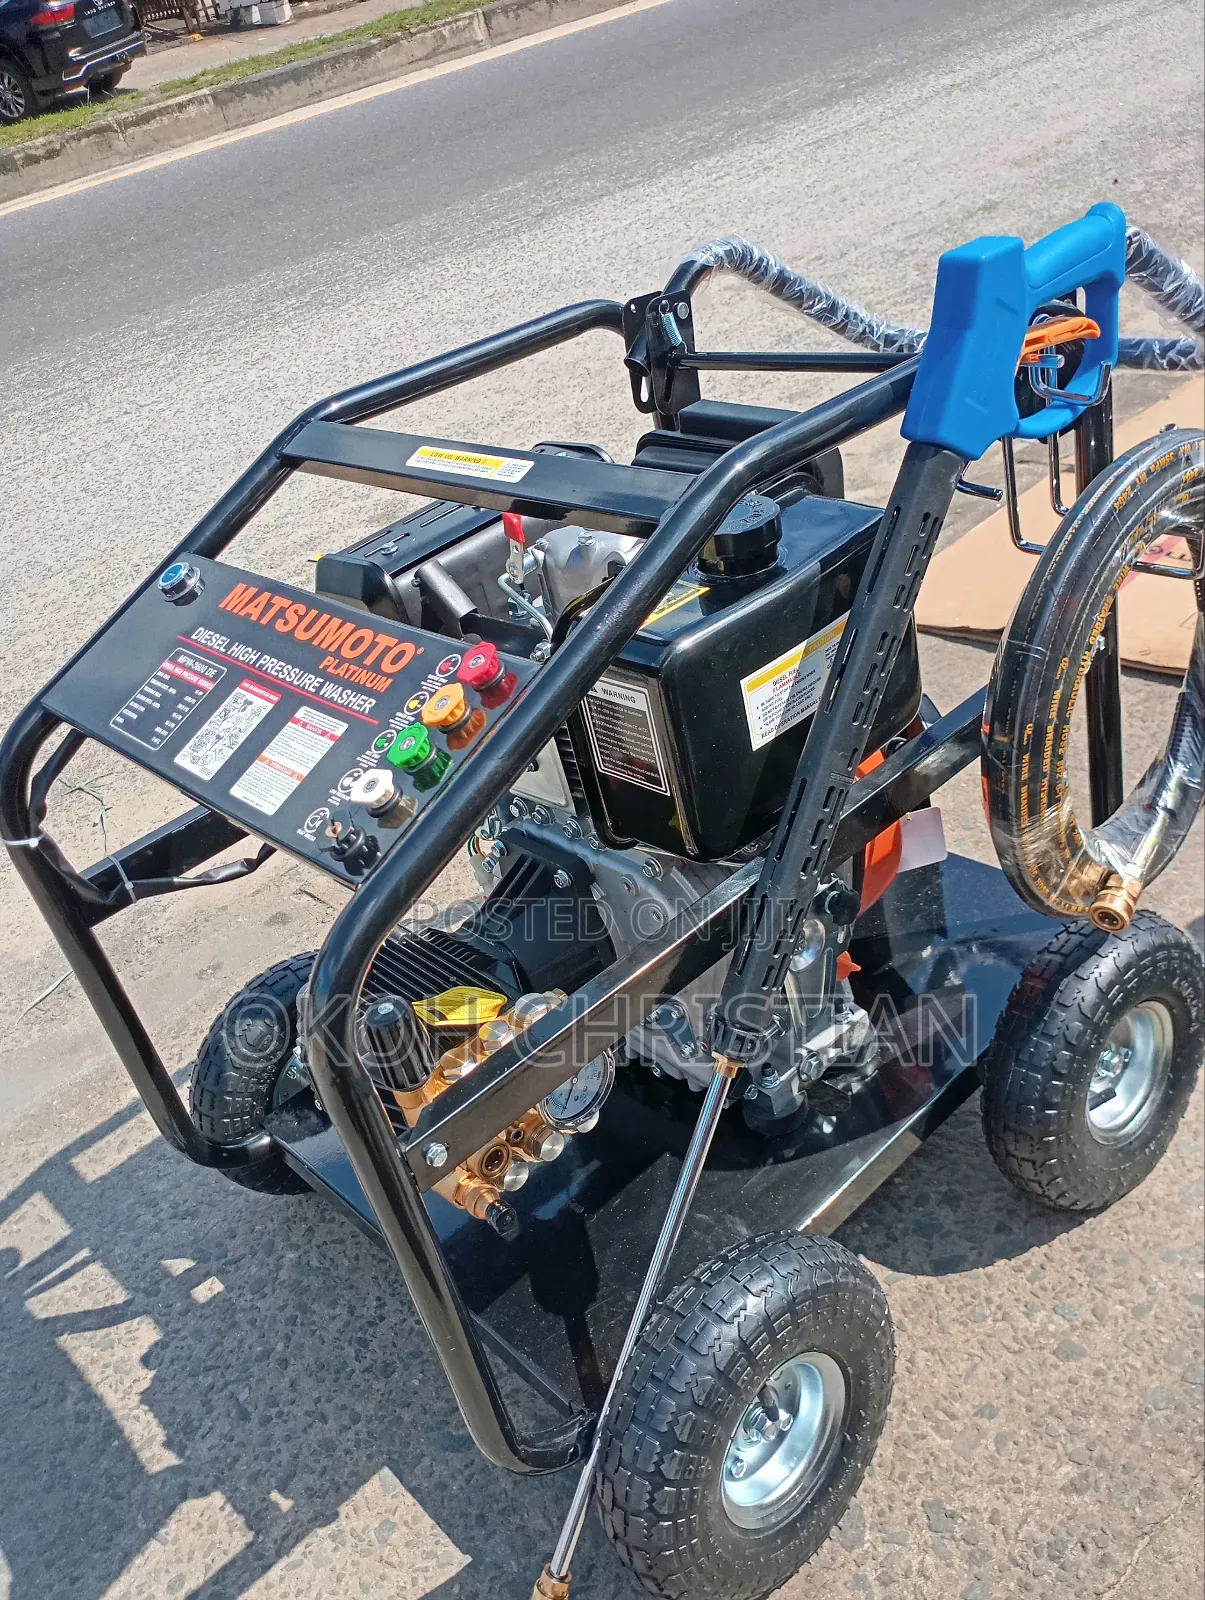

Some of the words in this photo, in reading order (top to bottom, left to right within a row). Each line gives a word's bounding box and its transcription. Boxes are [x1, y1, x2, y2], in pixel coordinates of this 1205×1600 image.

[454, 454, 482, 465] WARNING
[219, 582, 417, 674] MATSUMOTO
[1090, 594, 1114, 646] BRAIDED
[191, 626, 230, 653] DIESEL
[226, 641, 257, 666] HIGH
[256, 654, 326, 693] PRESSURE
[319, 683, 377, 715] WASHER
[205, 667, 218, 678] DE
[319, 656, 393, 693] PLATINUM
[772, 673, 788, 687] DIESEL
[1065, 649, 1091, 719] HYDRAULIC
[601, 687, 637, 704] WARNING
[1048, 688, 1061, 719] WIRE
[1042, 724, 1057, 773] BRAIDED
[1021, 752, 1030, 780] WIRE
